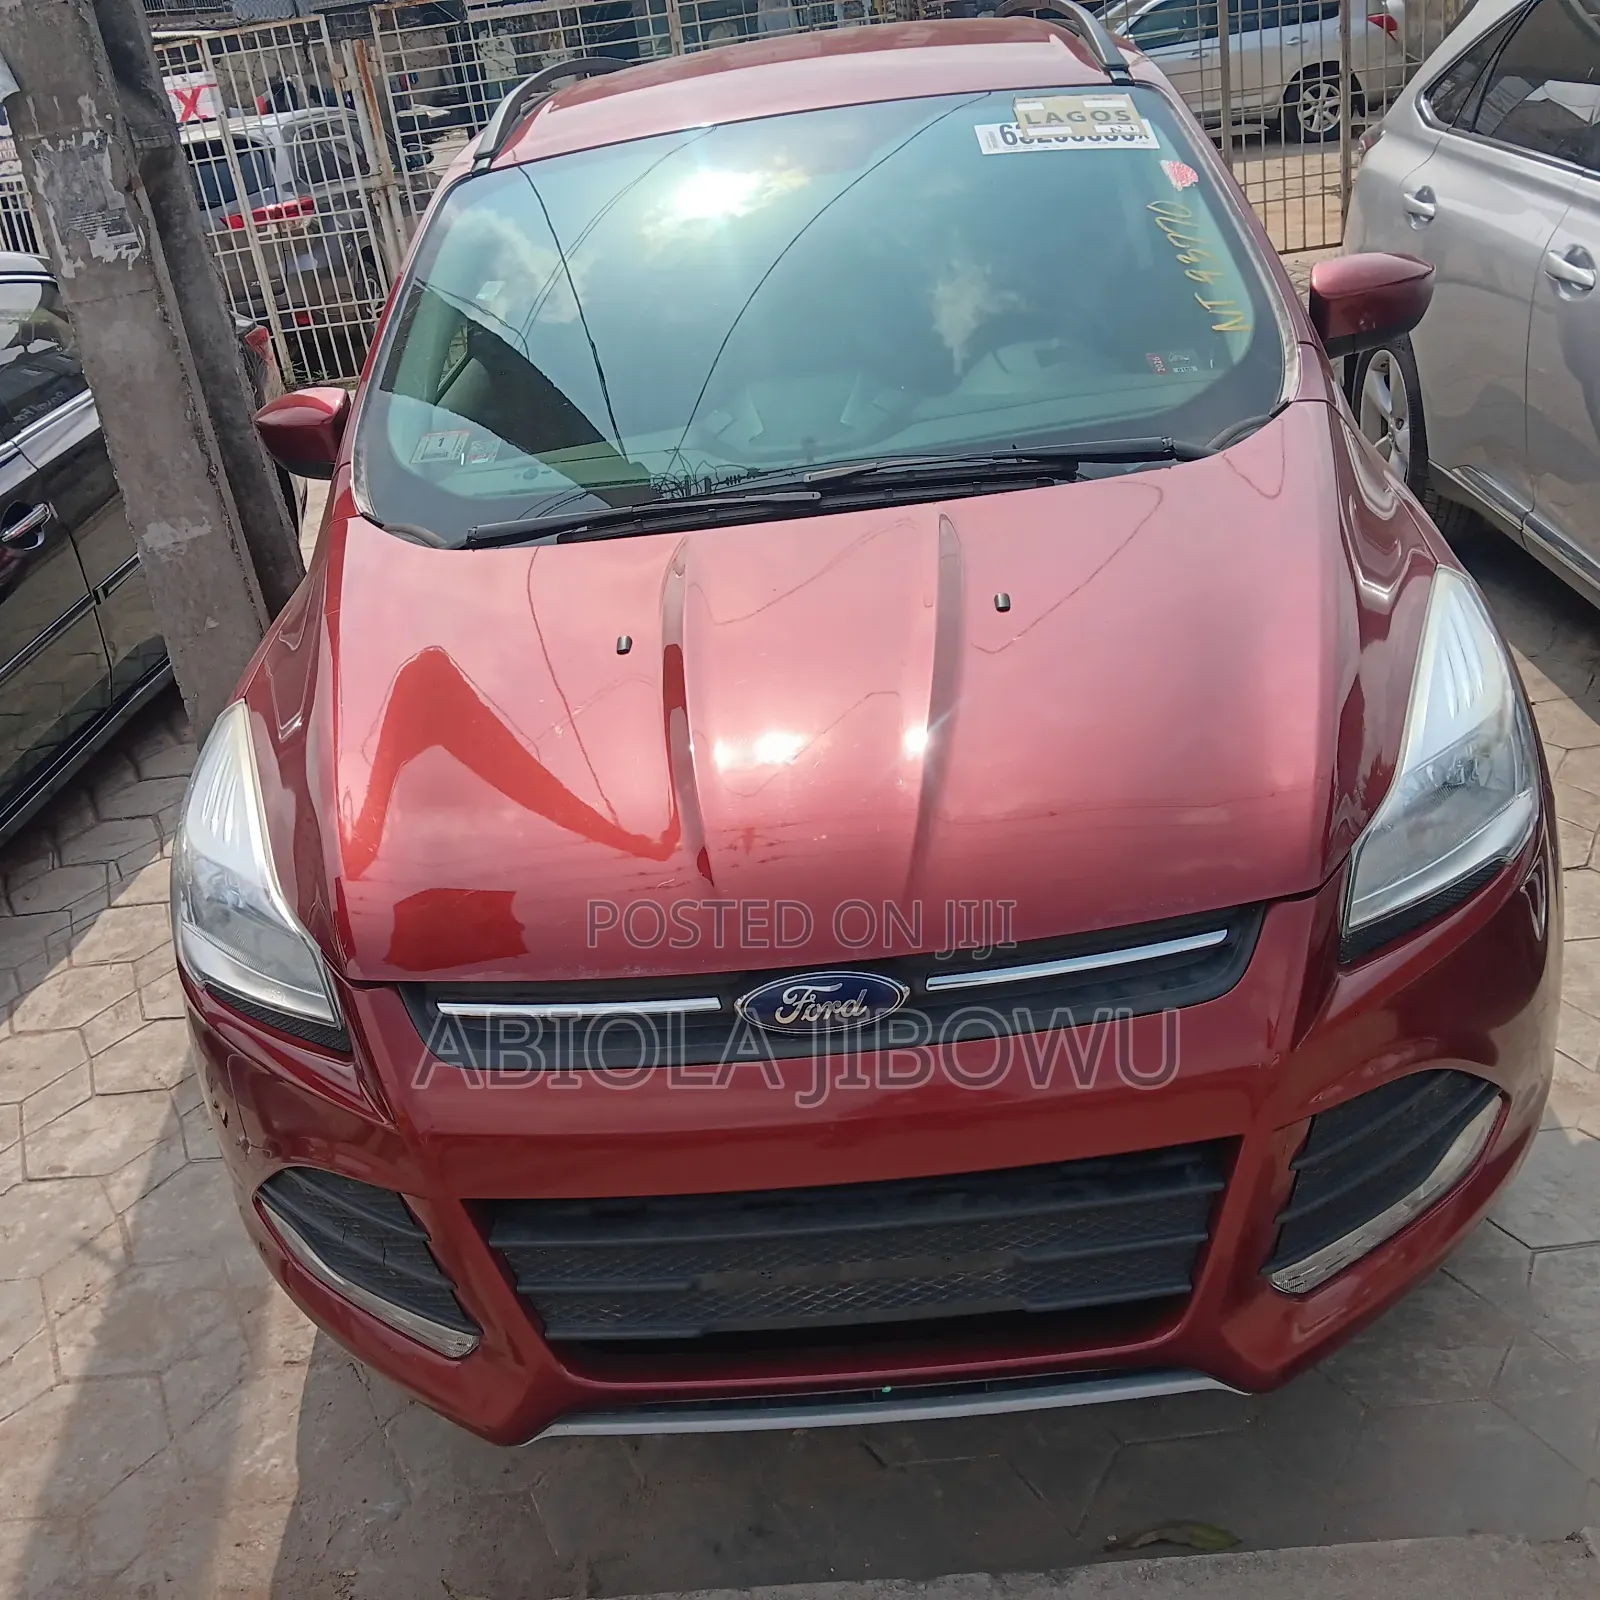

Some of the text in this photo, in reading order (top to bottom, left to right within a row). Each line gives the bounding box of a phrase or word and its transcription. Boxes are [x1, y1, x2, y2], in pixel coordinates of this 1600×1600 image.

[1024, 109, 1132, 125] LAGOS
[1194, 292, 1251, 331] NT
[774, 982, 868, 1025] Ford
